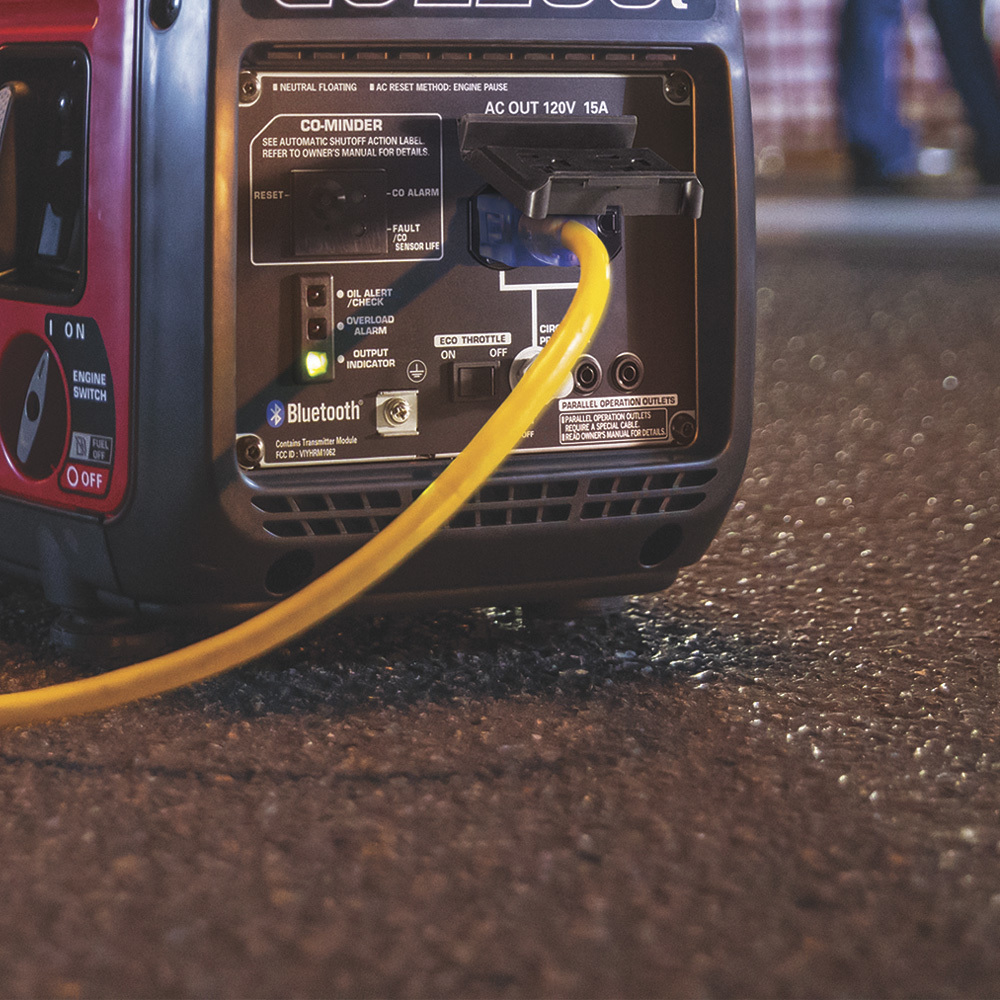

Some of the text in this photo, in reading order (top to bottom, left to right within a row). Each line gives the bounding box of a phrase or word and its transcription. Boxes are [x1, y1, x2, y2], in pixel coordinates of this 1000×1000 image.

[279, 82, 358, 92] NEUTRAL FLOATING
[375, 82, 509, 92] AC RESET METHOD: ENGINE PAUSE
[484, 100, 609, 115] AC OUT 120V 15A
[300, 118, 383, 132] CO-MINDER
[262, 137, 278, 147] SEE
[279, 137, 328, 147] AUTOMATIC
[329, 136, 366, 146] SHUTOFF
[367, 136, 398, 145] ACTION
[262, 147, 431, 158] REFER TO OWNER'S MANUAL FOR DETAILS.
[253, 190, 285, 200] RESET
[391, 188, 440, 197] CO ALARM
[392, 224, 421, 233] FAULT
[392, 233, 408, 243] /CO
[395, 242, 440, 251] SENSOR LIFE
[346, 288, 393, 298] OIL ALERT
[346, 298, 384, 308] /CHECK
[346, 315, 395, 326] OVERLOAD
[64, 320, 86, 340] ON
[354, 326, 388, 336] ALARM
[439, 335, 507, 345] ECO THROTTLE
[353, 348, 389, 358] OUTPUT
[440, 350, 456, 360] ON
[489, 348, 508, 358] OFF
[346, 358, 396, 369] INDICATOR
[72, 369, 107, 386] ENGINE
[73, 385, 107, 402] SWITCH
[561, 395, 676, 409] PARALLEL OPERATION OUTLETS
[564, 411, 652, 423] PARALLEL OPERATION OUTLETS
[565, 423, 590, 434] REQUIRE
[590, 422, 596, 431] A
[596, 421, 620, 431] SPECIAL
[565, 432, 580, 441] READ
[580, 431, 606, 441] OWNER'S
[606, 429, 630, 439] MANUAL
[630, 428, 642, 437] FOR
[91, 437, 109, 450] FUEL
[275, 435, 358, 449] Contains Transmitter Module
[92, 449, 106, 460] OFF
[275, 450, 288, 459] FCC
[81, 471, 103, 489] OFF
